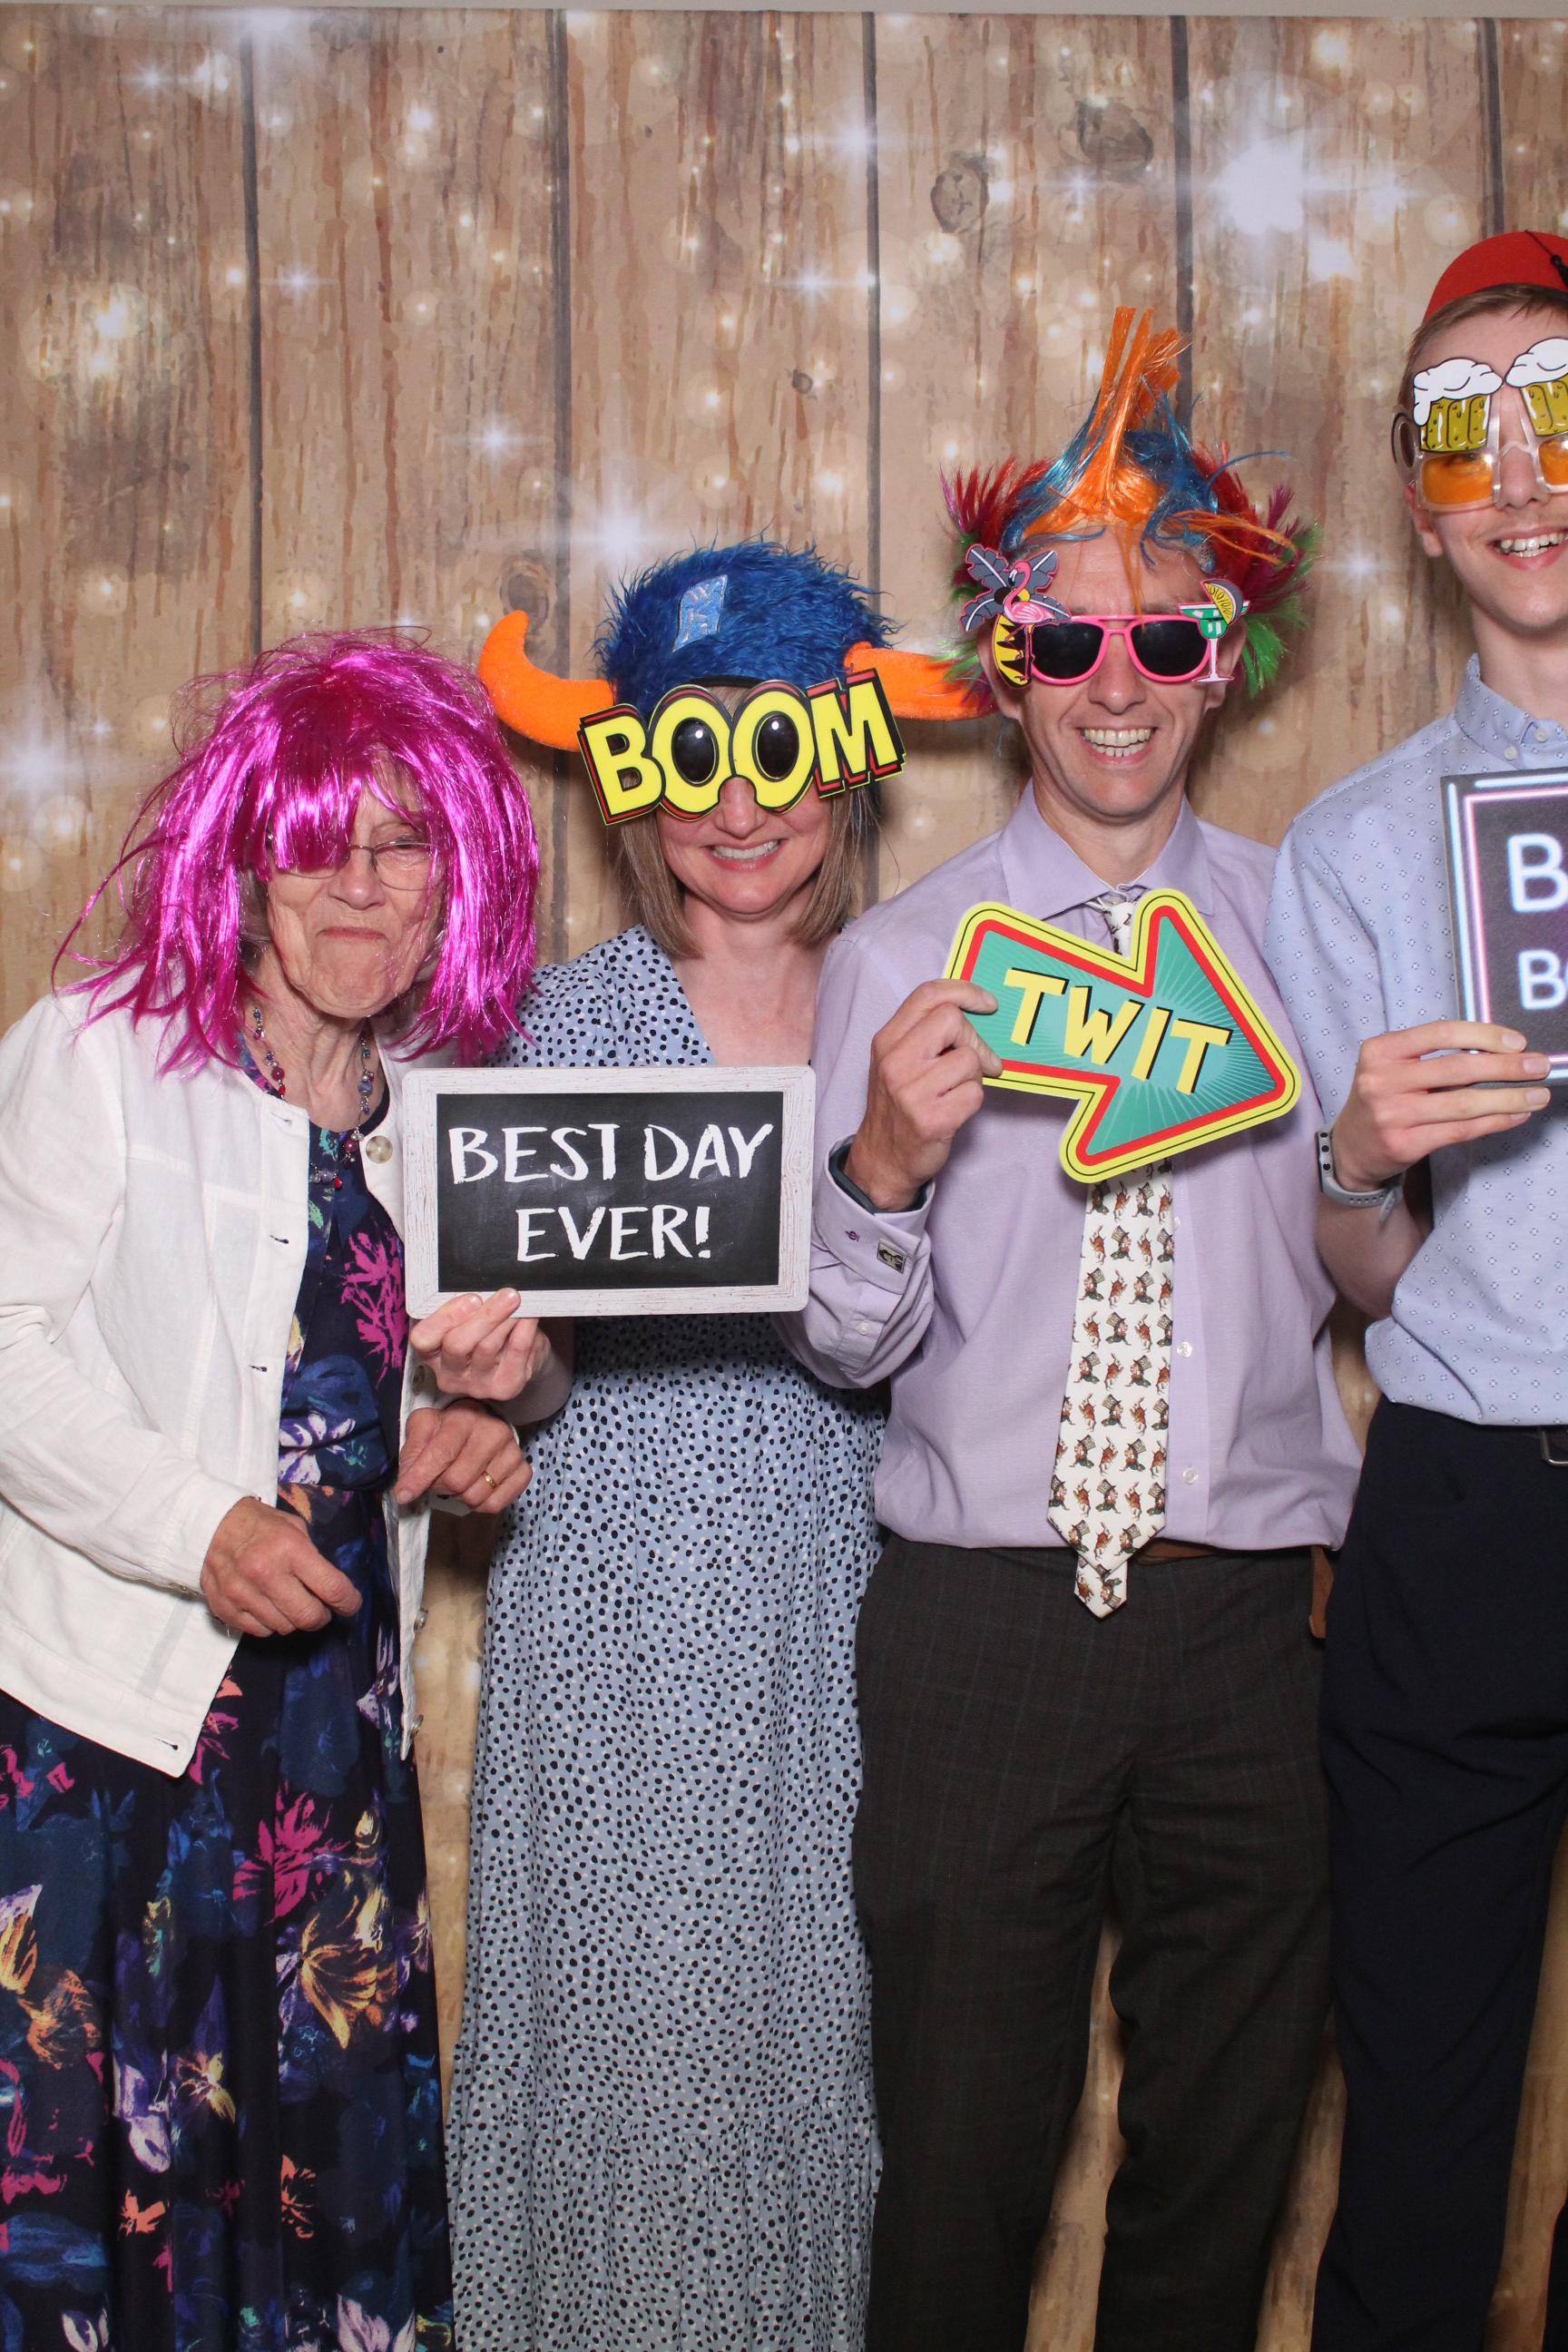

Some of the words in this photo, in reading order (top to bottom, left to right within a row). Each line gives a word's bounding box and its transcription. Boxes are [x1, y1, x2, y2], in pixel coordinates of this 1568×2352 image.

[577, 669, 906, 824] BOOM
[1004, 967, 1233, 1095] TWIT
[448, 1123, 620, 1184] BEST
[643, 1123, 774, 1181] DAY
[515, 1204, 711, 1261] EVER!
